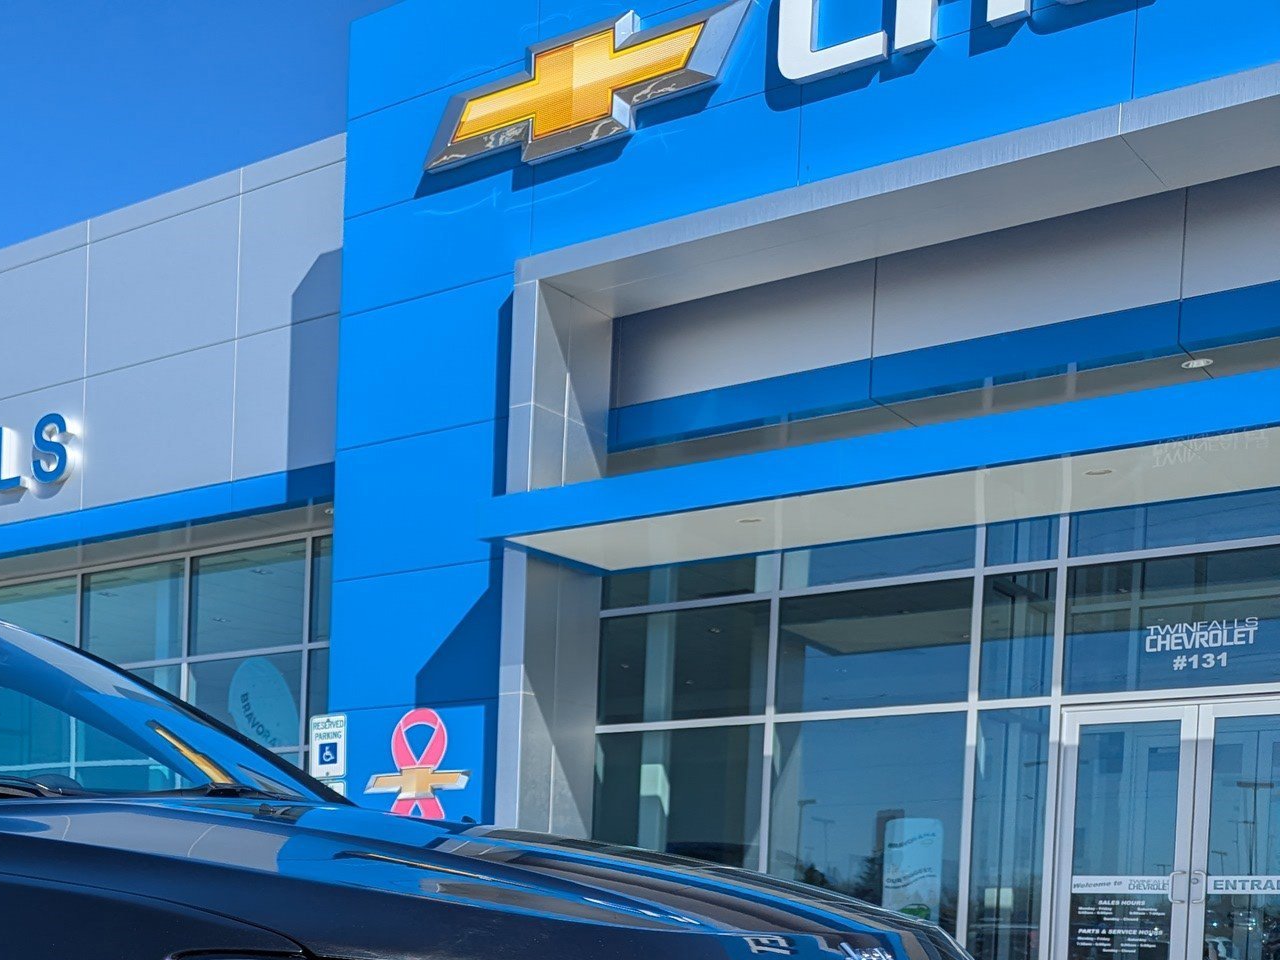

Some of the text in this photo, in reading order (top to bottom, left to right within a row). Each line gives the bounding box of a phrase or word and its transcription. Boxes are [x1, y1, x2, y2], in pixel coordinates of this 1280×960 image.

[1146, 616, 1258, 636] TWINFALLS
[1145, 627, 1258, 652] CHEVROLET
[1172, 652, 1227, 671] #131
[312, 719, 345, 730] RESERVED
[314, 730, 342, 742] PARKING
[1073, 881, 1111, 889] Welcome
[1213, 879, 1280, 891] ENTRA
